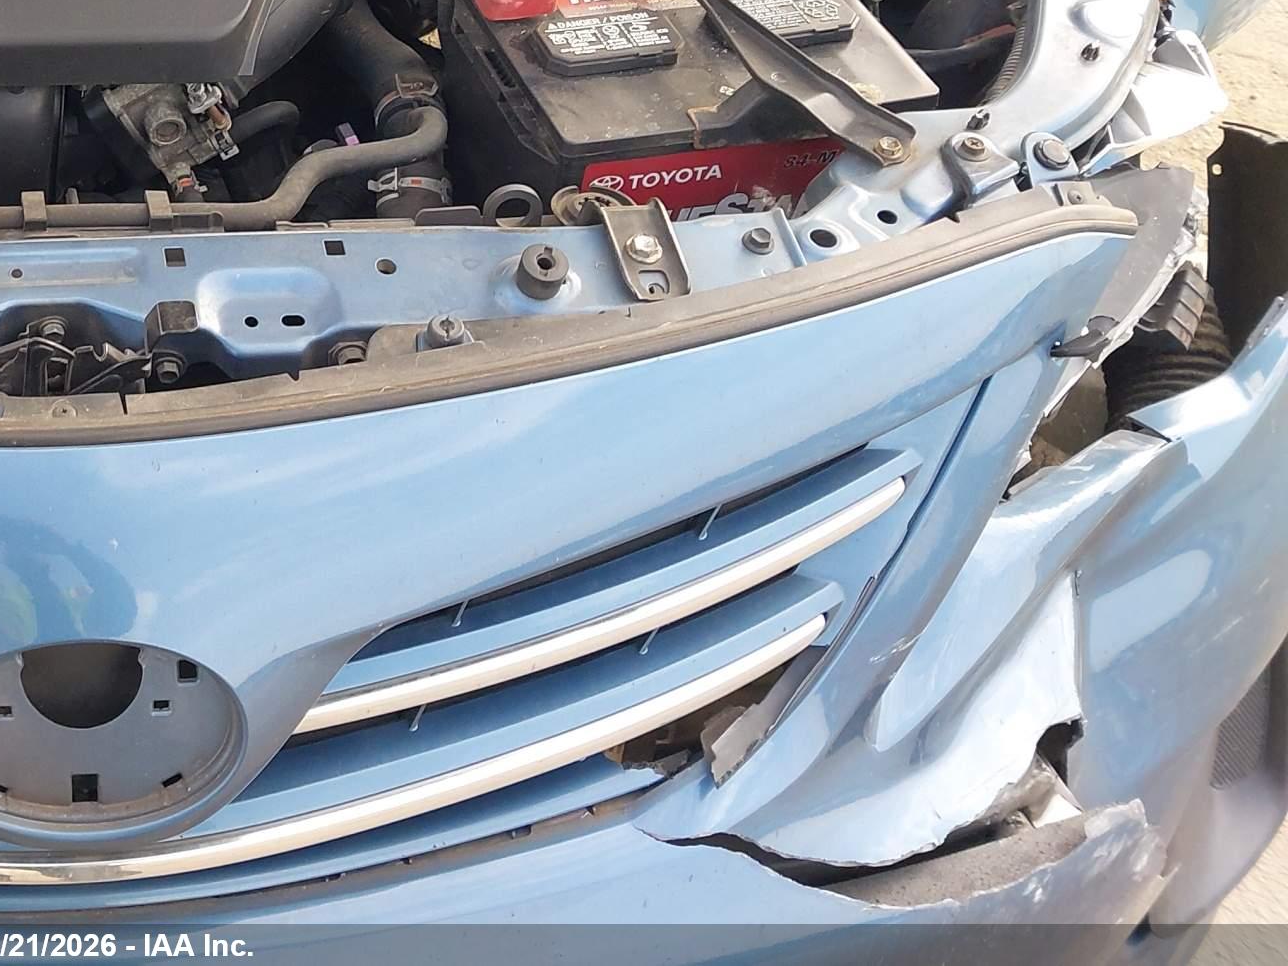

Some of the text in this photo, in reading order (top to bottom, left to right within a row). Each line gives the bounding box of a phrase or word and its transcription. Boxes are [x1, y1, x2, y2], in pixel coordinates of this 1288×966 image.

[556, 18, 600, 30] DANGER
[609, 12, 651, 23] POISON
[628, 164, 722, 190] TOYOTA
